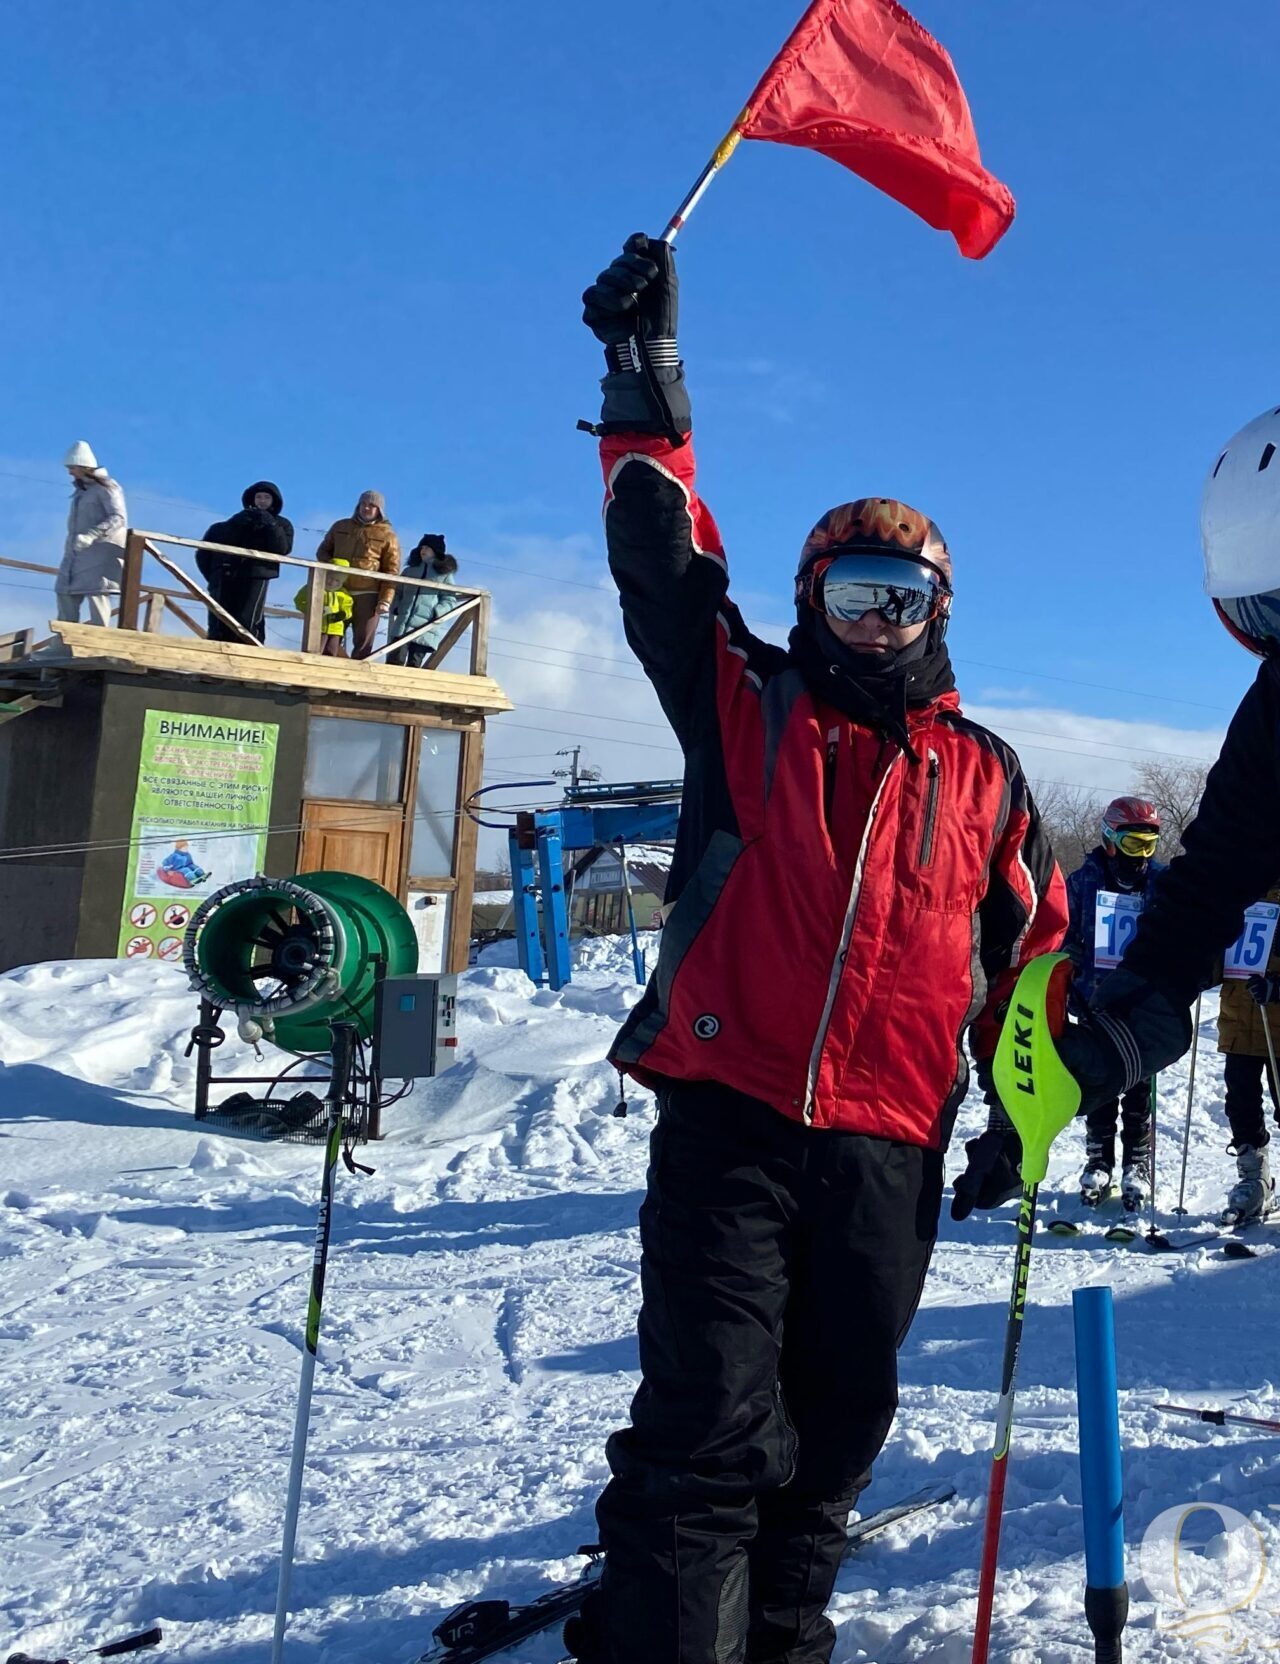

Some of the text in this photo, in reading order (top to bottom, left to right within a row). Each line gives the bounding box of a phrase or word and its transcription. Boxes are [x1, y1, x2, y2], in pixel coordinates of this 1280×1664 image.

[160, 720, 266, 745] ВНИМАНИЕ!
[143, 776, 158, 784] ВСЕ
[160, 777, 207, 788] СВЯЗАННЫЕ
[218, 782, 240, 791] ЭТИМ
[241, 784, 268, 792] РИСКИ
[152, 787, 194, 797] ЯВЛЯЮТСЯ
[163, 799, 244, 811] ОТВЕТСТВЕННОСТЬЮ
[1102, 913, 1138, 956] 12
[1233, 922, 1267, 966] 15
[1014, 1003, 1035, 1096] LEKI
[1015, 1183, 1035, 1321] EKI LEKI
